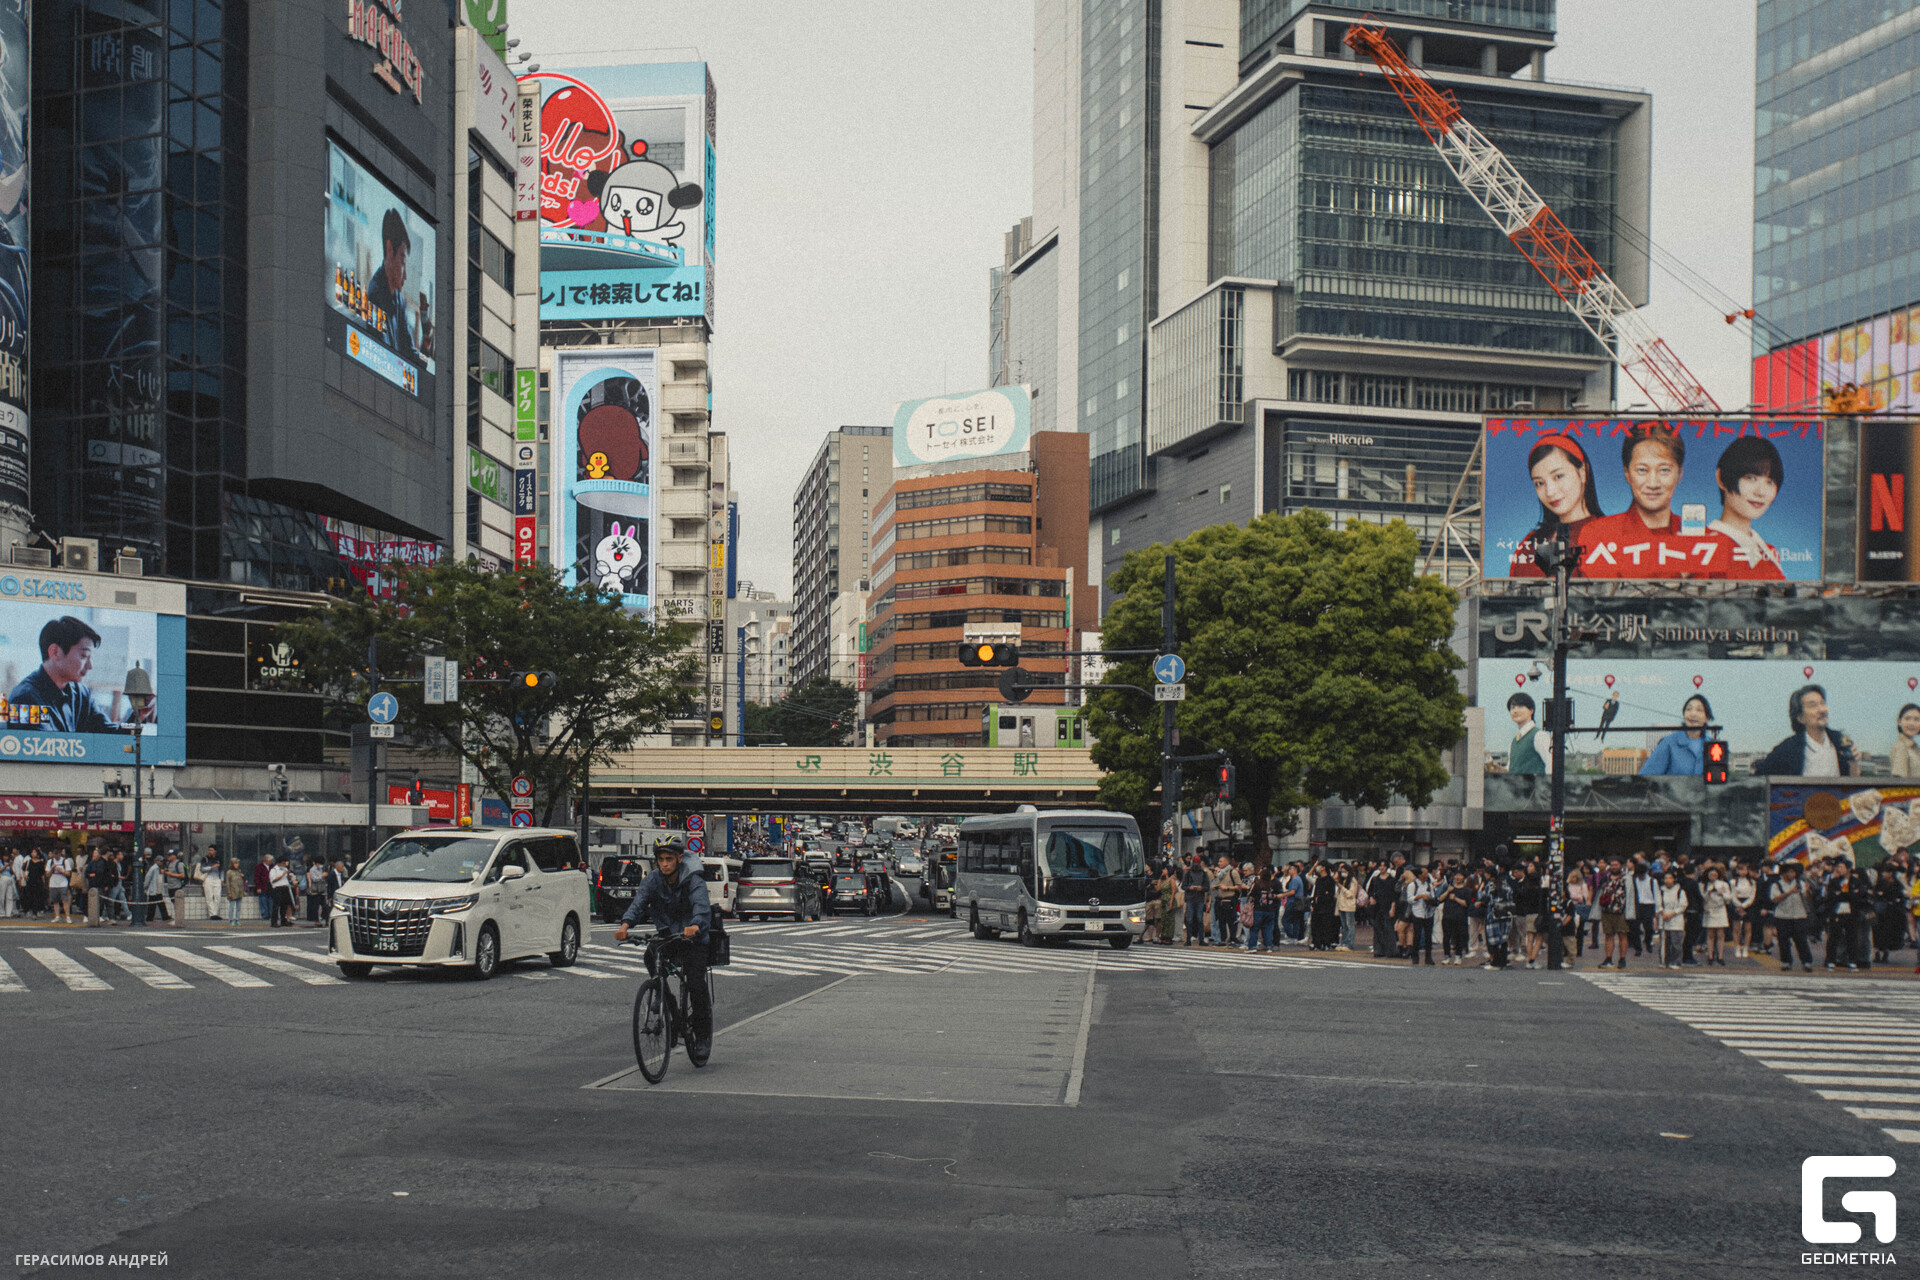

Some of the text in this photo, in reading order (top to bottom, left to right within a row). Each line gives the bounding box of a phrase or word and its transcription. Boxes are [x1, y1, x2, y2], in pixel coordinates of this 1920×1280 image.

[349, 0, 424, 105] MAGNET
[520, 376, 532, 412] レイク
[926, 415, 995, 439] TOSEI
[926, 434, 995, 451] トーセイ株式会社
[1329, 432, 1374, 446] Hikarie
[471, 455, 496, 487] レイク
[1497, 537, 1549, 550] ペイしてト
[1585, 541, 1718, 566] ペイトク
[22, 577, 86, 600] STARTS
[664, 599, 694, 607] DARTS
[1495, 612, 1549, 642] JR
[1655, 625, 1730, 643] shibuya
[1735, 626, 1799, 642] station
[712, 656, 722, 664] 3F
[260, 667, 306, 679] COFE
[22, 737, 86, 758] STARTS
[796, 751, 1039, 777] JR 渋谷駅
